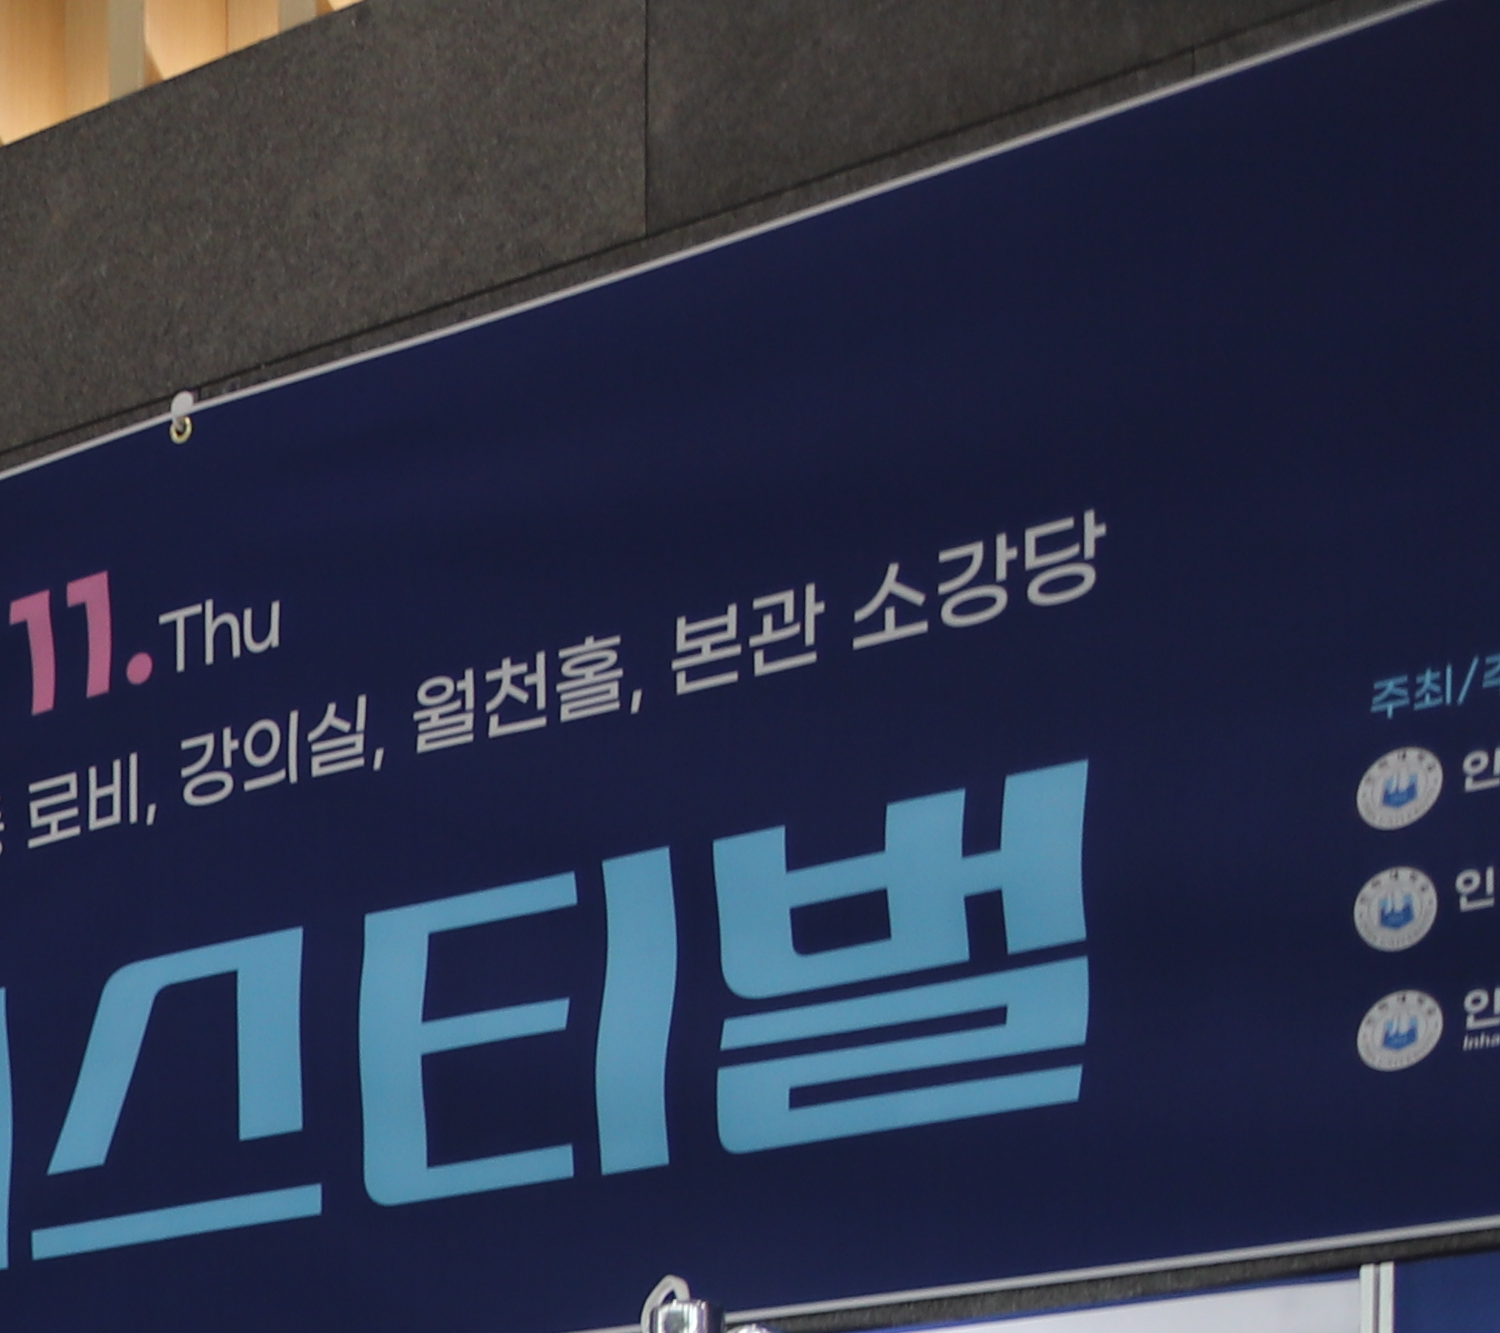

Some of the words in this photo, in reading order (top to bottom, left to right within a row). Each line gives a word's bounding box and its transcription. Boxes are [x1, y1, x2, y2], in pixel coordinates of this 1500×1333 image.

[25, 748, 160, 854] 로비,
[179, 697, 385, 810] 강의실,
[413, 635, 644, 752] 월천홀,
[669, 586, 828, 698] 본관
[851, 512, 1109, 653] 소강당
